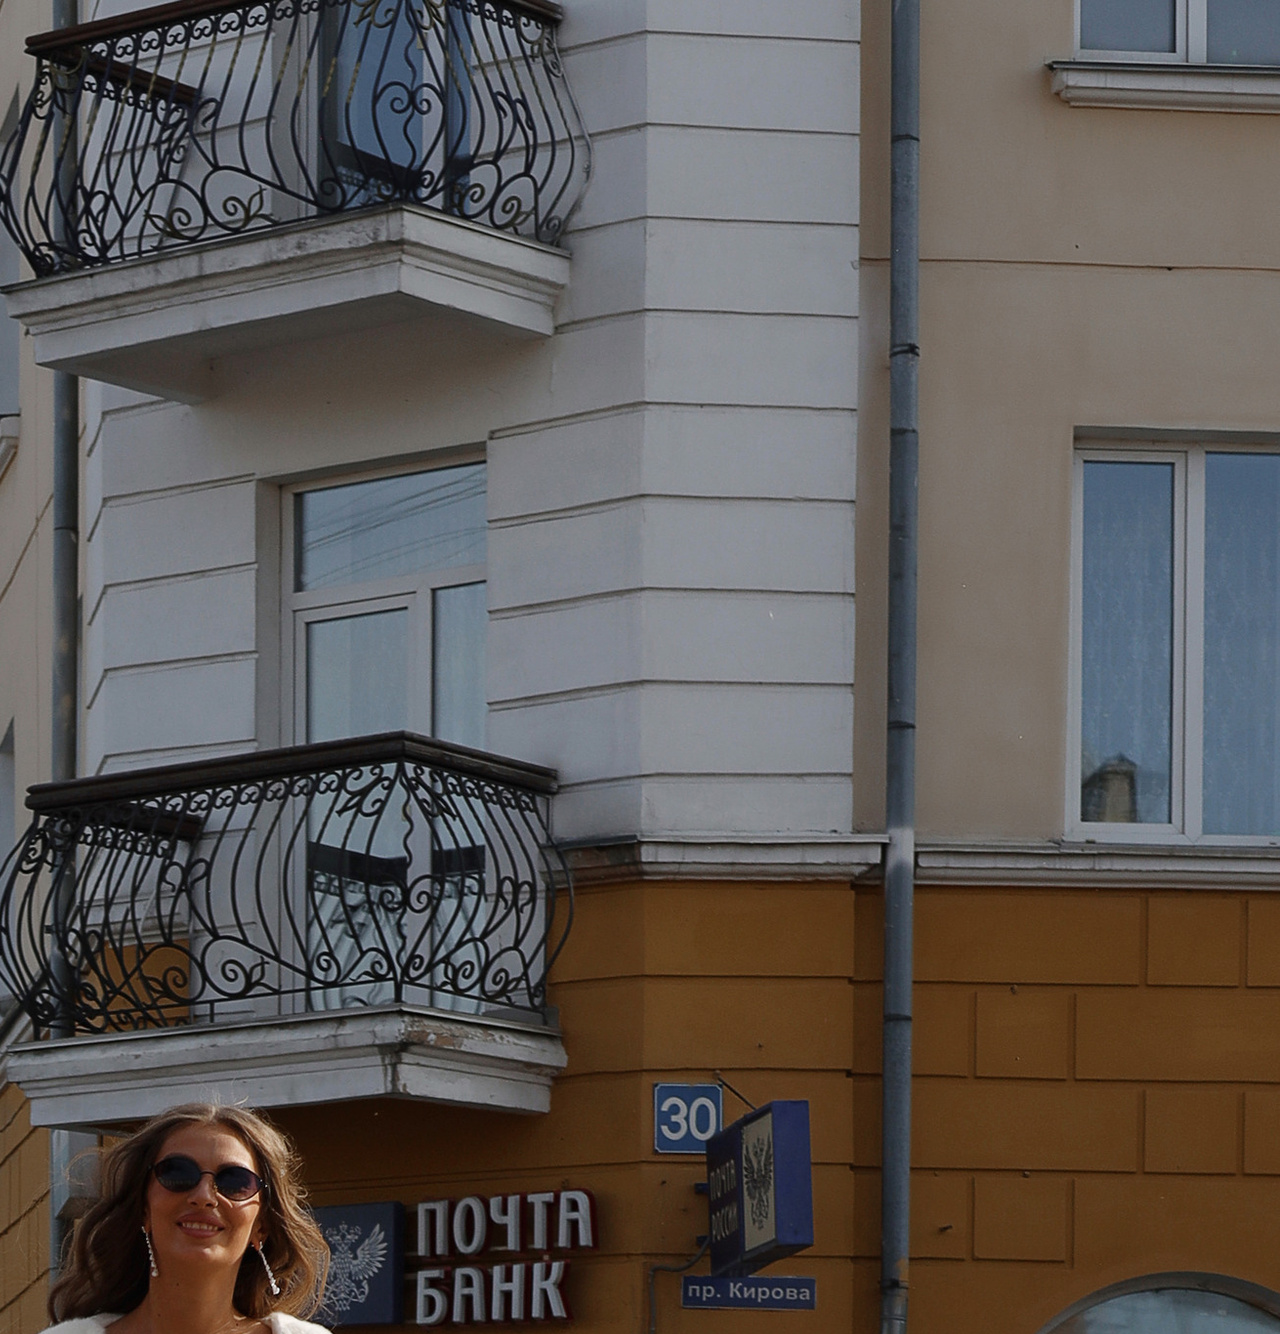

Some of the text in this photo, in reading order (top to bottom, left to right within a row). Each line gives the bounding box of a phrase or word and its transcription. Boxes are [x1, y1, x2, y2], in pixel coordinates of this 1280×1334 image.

[660, 1096, 717, 1142] 30
[710, 1158, 738, 1202] ПОЧТА
[417, 1189, 595, 1258] ПОЧТА
[416, 1260, 569, 1325] БАНК
[687, 1282, 811, 1302] пр. Кирова
